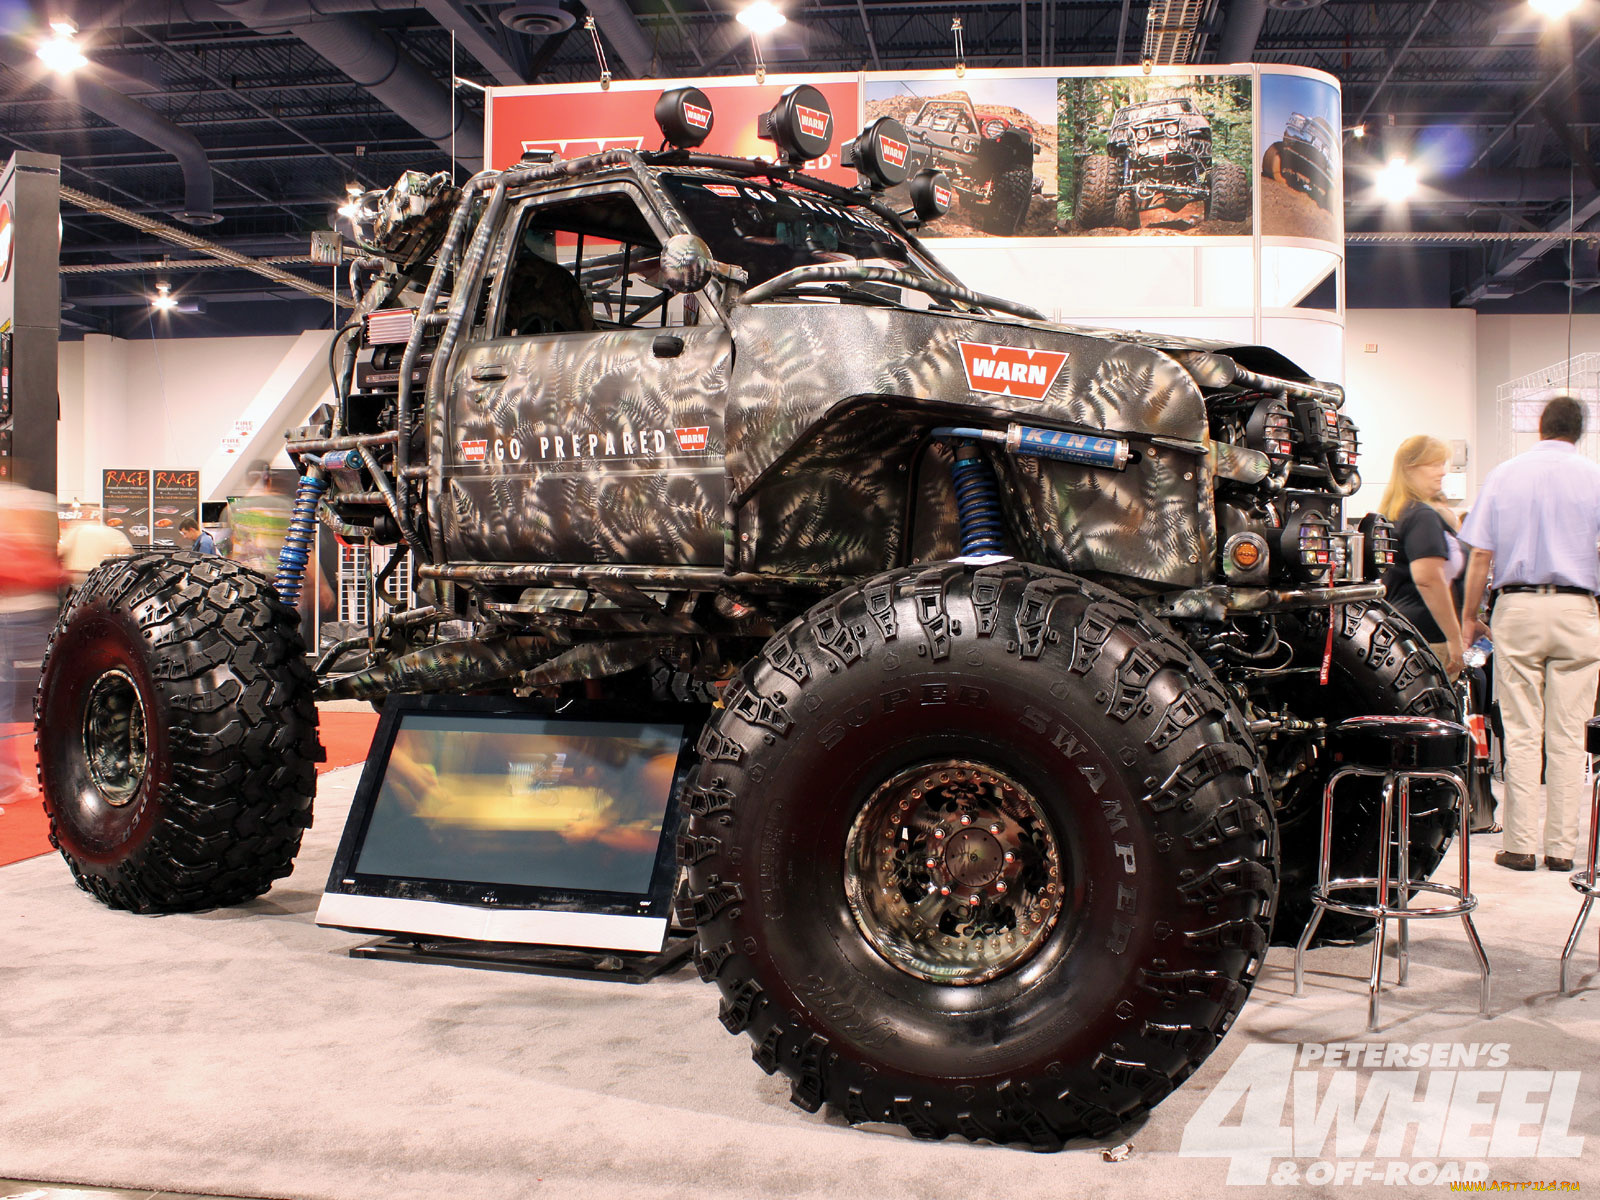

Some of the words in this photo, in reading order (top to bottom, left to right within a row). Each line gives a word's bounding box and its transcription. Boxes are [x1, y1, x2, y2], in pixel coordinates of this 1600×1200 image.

[686, 109, 707, 123] WARN
[801, 114, 824, 131] WARN
[883, 144, 904, 161] WARN
[744, 187, 778, 203] GO
[972, 357, 1047, 386] WARN
[493, 438, 521, 461] GO
[1026, 429, 1114, 453] KING
[106, 470, 149, 489] RAGE
[156, 471, 197, 489] RAGE
[816, 682, 991, 751] SUPER
[1018, 704, 1138, 955] SWAMPER
